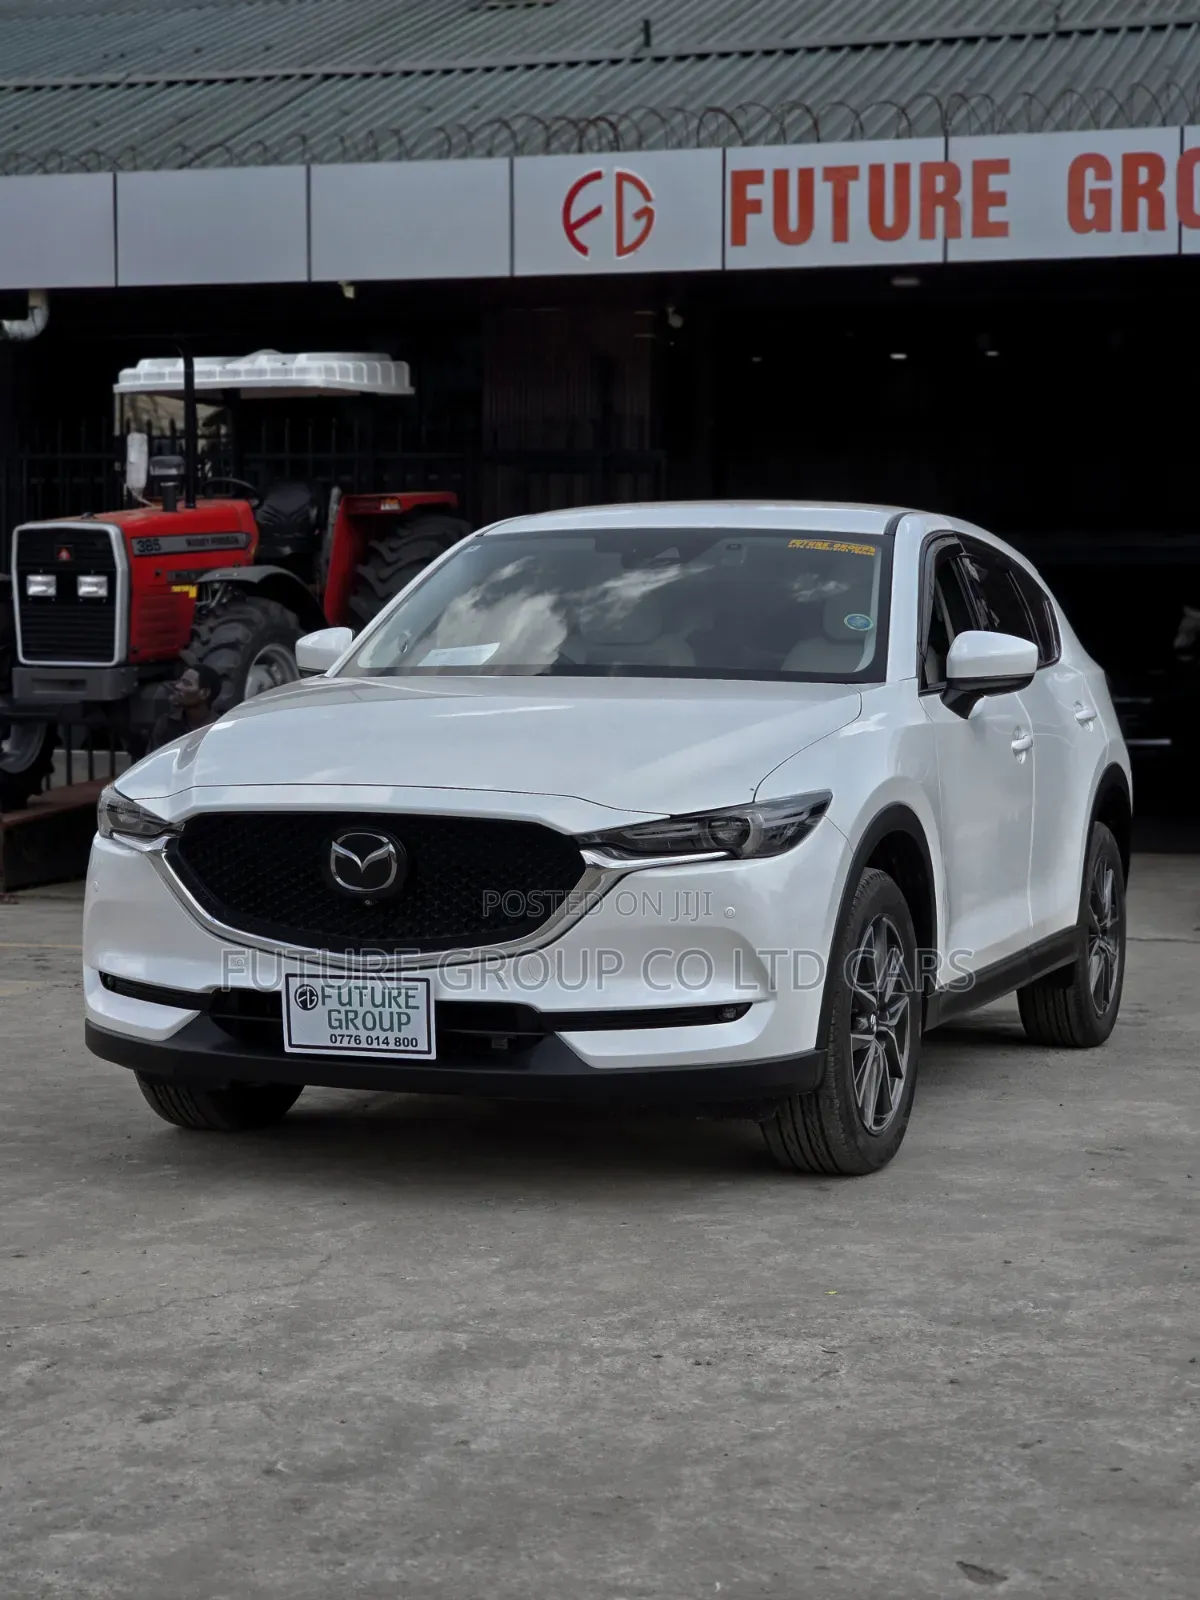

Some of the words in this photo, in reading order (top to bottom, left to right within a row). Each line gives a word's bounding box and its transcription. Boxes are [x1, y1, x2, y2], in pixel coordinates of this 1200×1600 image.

[730, 158, 1011, 247] FUTURE
[321, 984, 420, 1009] FUTURE
[327, 1008, 412, 1032] GROUP
[329, 1033, 362, 1045] 0776
[365, 1035, 390, 1046] 014
[394, 1036, 418, 1048] 800
